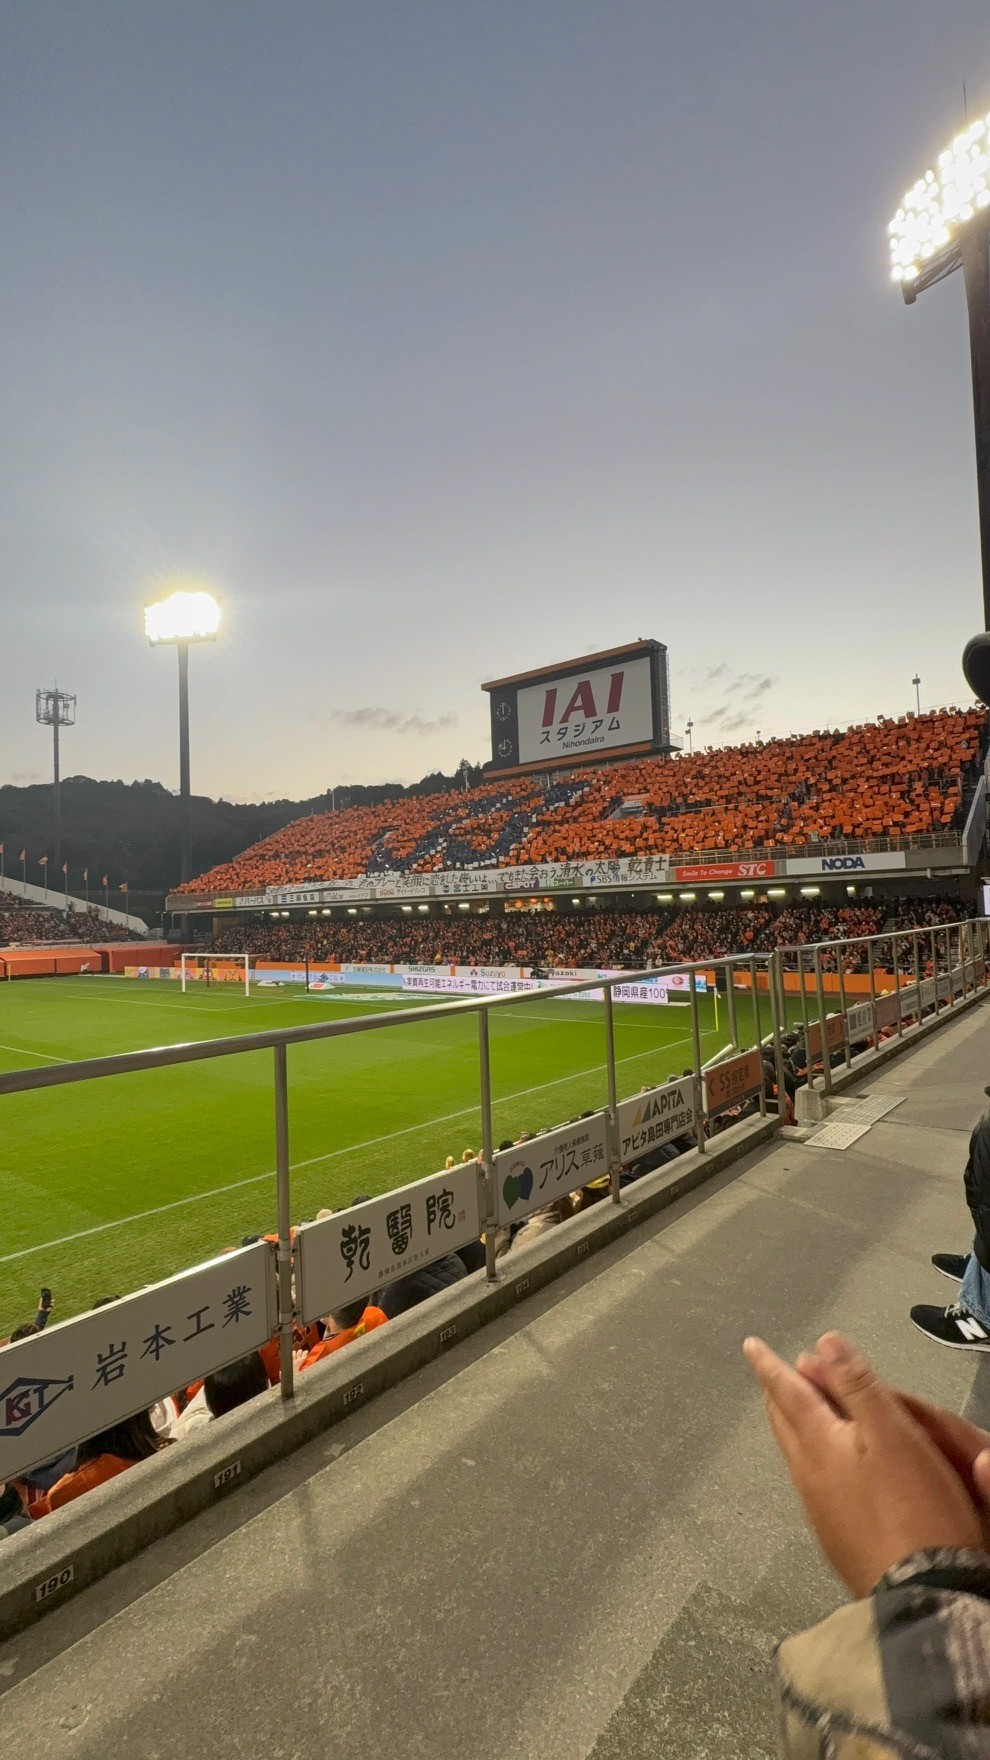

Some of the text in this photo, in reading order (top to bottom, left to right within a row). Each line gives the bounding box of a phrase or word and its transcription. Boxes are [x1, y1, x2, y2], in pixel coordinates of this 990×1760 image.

[541, 671, 624, 728] IAI
[539, 716, 621, 745] スタジアム
[562, 735, 605, 750] Nihondaira
[681, 867, 733, 878] Smile To Change
[737, 862, 767, 877] STC
[821, 856, 865, 870] NODA
[480, 968, 506, 978] Suzuyo
[612, 985, 668, 1000] 静岡県産100
[621, 1107, 694, 1156] アピタ島田専門店会
[538, 1143, 605, 1190] アリス草薙
[90, 1285, 253, 1391] 岩本工業
[955, 1317, 988, 1341] N
[345, 1385, 362, 1403] 192
[217, 1464, 239, 1485] 191
[38, 1569, 72, 1598] 190
